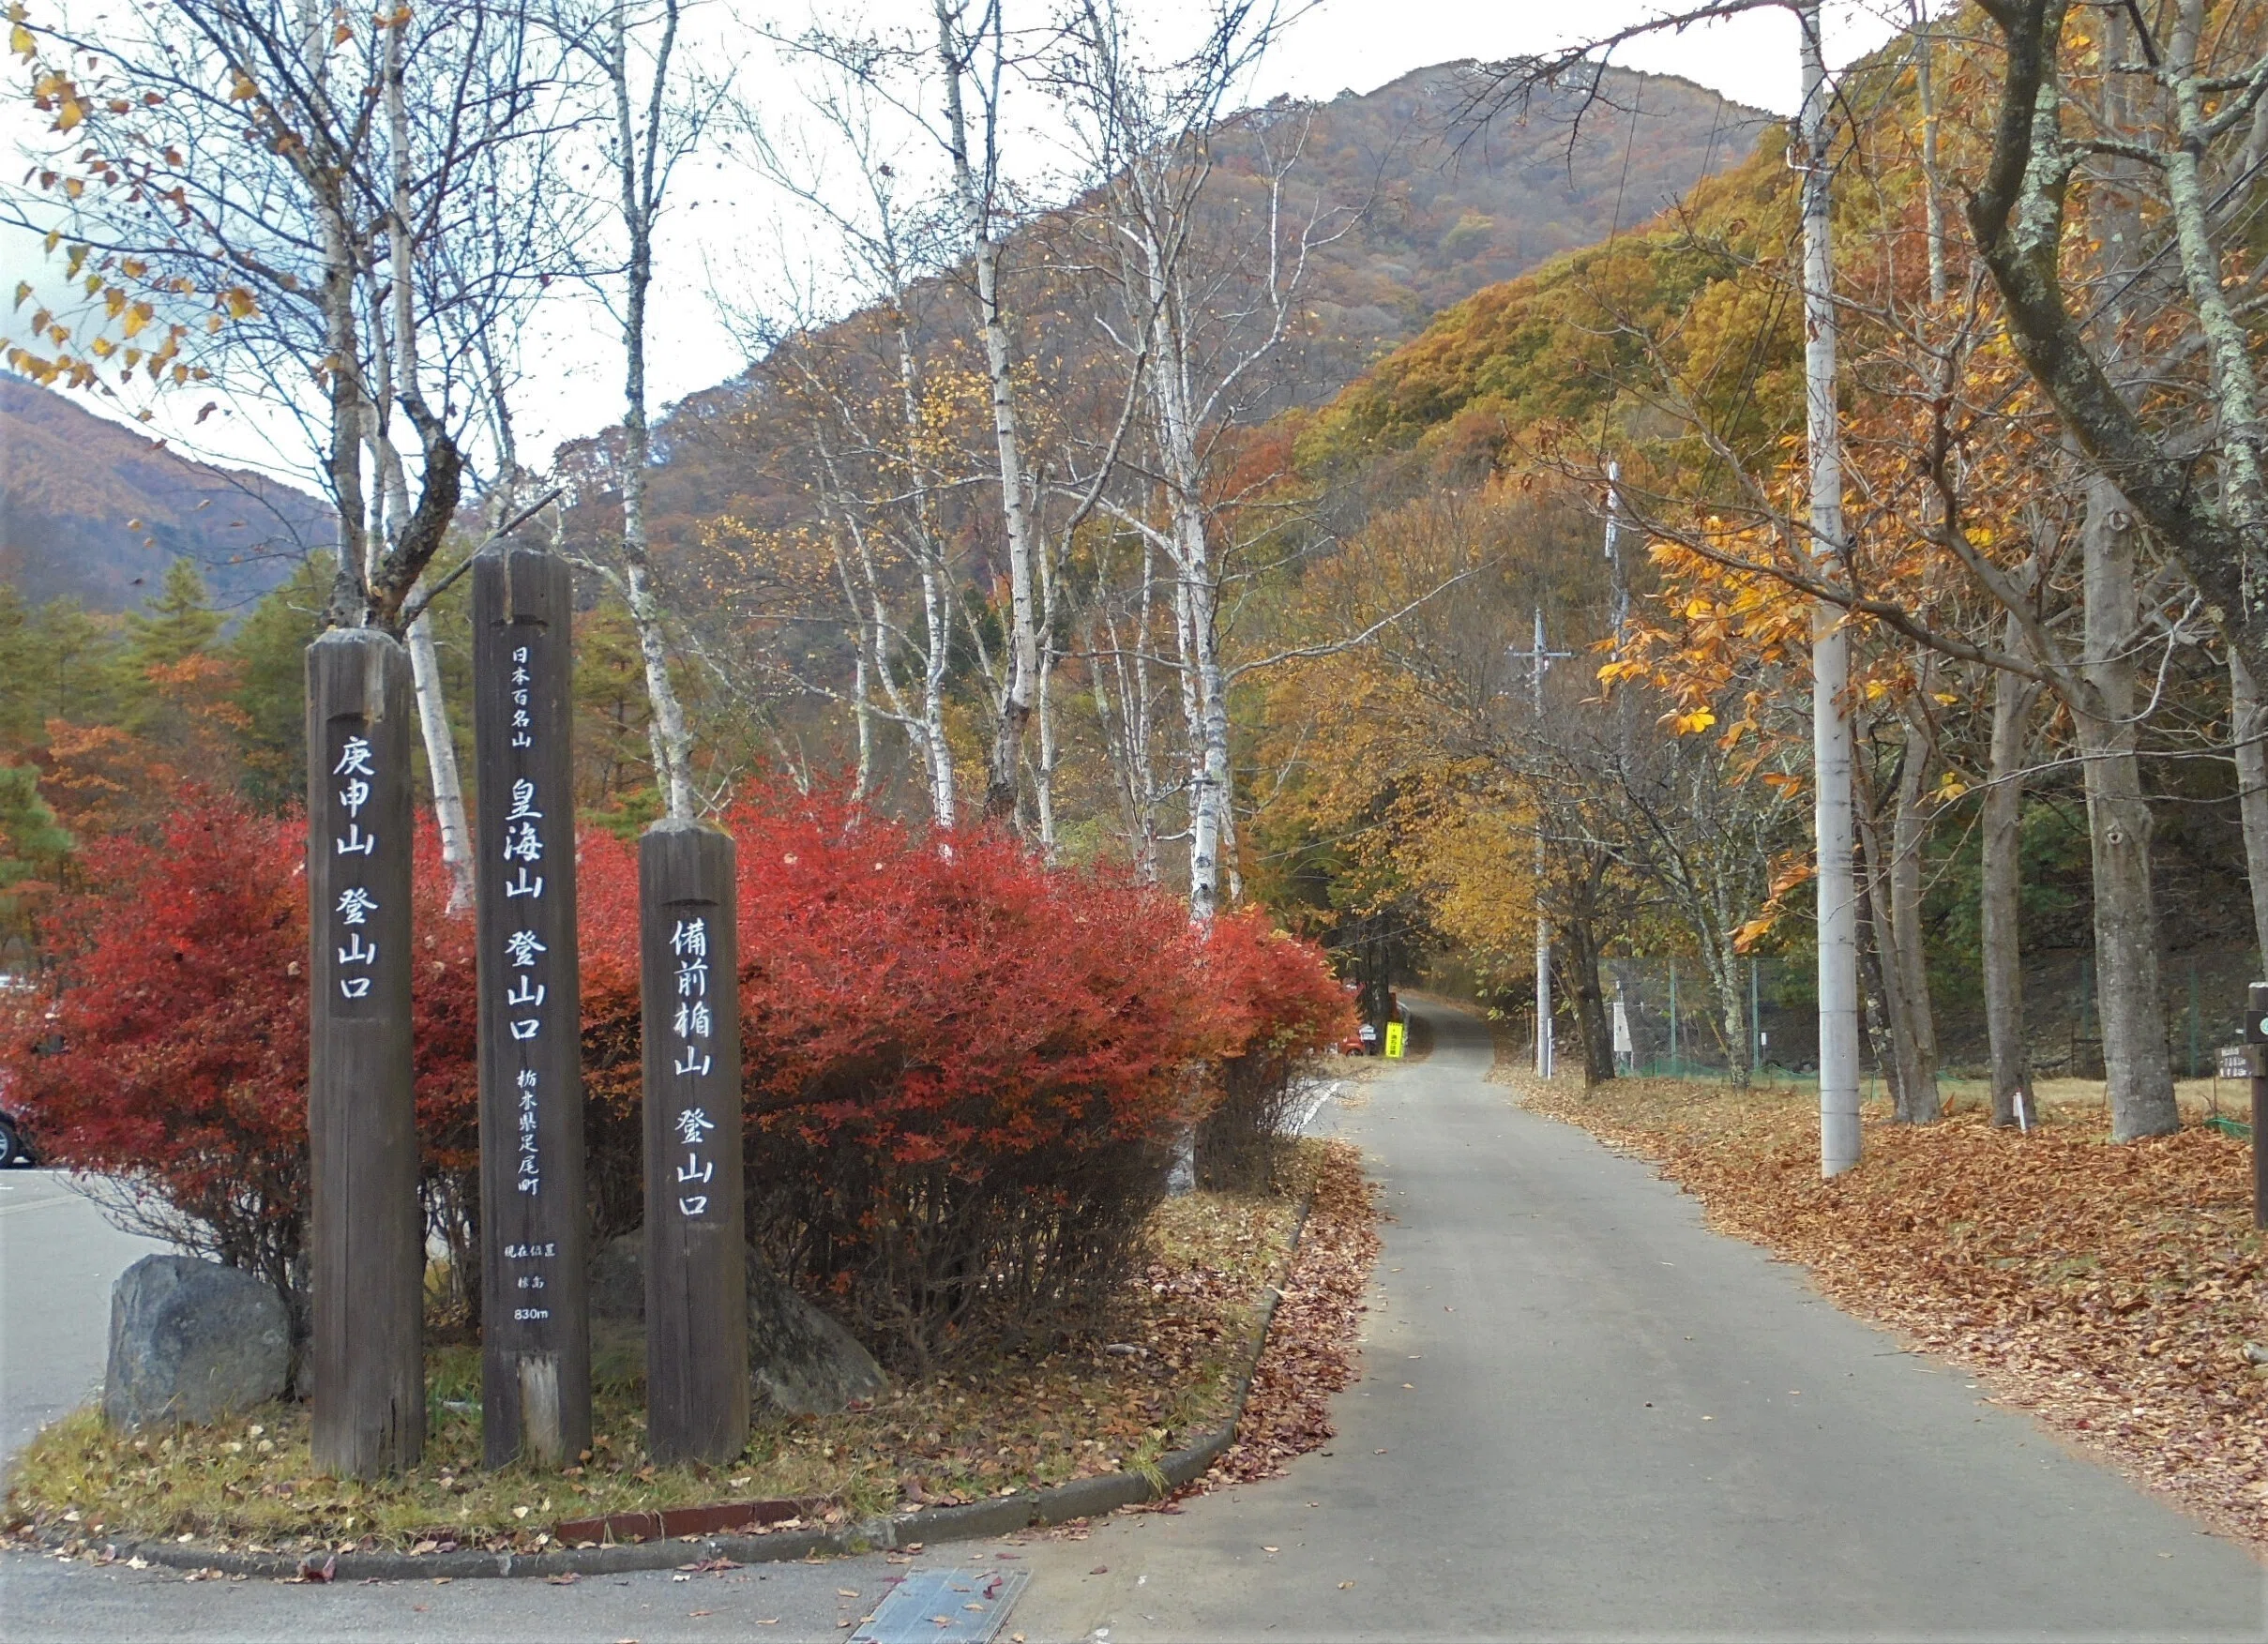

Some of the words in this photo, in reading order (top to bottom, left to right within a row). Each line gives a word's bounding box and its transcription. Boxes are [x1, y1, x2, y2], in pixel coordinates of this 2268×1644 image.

[511, 646, 531, 747] 日本百名山
[332, 735, 376, 855] 庚申山
[504, 777, 544, 897] 皇海山
[335, 887, 378, 999] 登山口
[504, 929, 546, 1039] 登山口
[669, 916, 711, 1077] 備前楯山
[516, 1069, 539, 1196] 栃木県足尾町
[673, 1107, 715, 1216] 登山口
[504, 1243, 555, 1258] 現在位置
[514, 1308, 549, 1320] 830m
